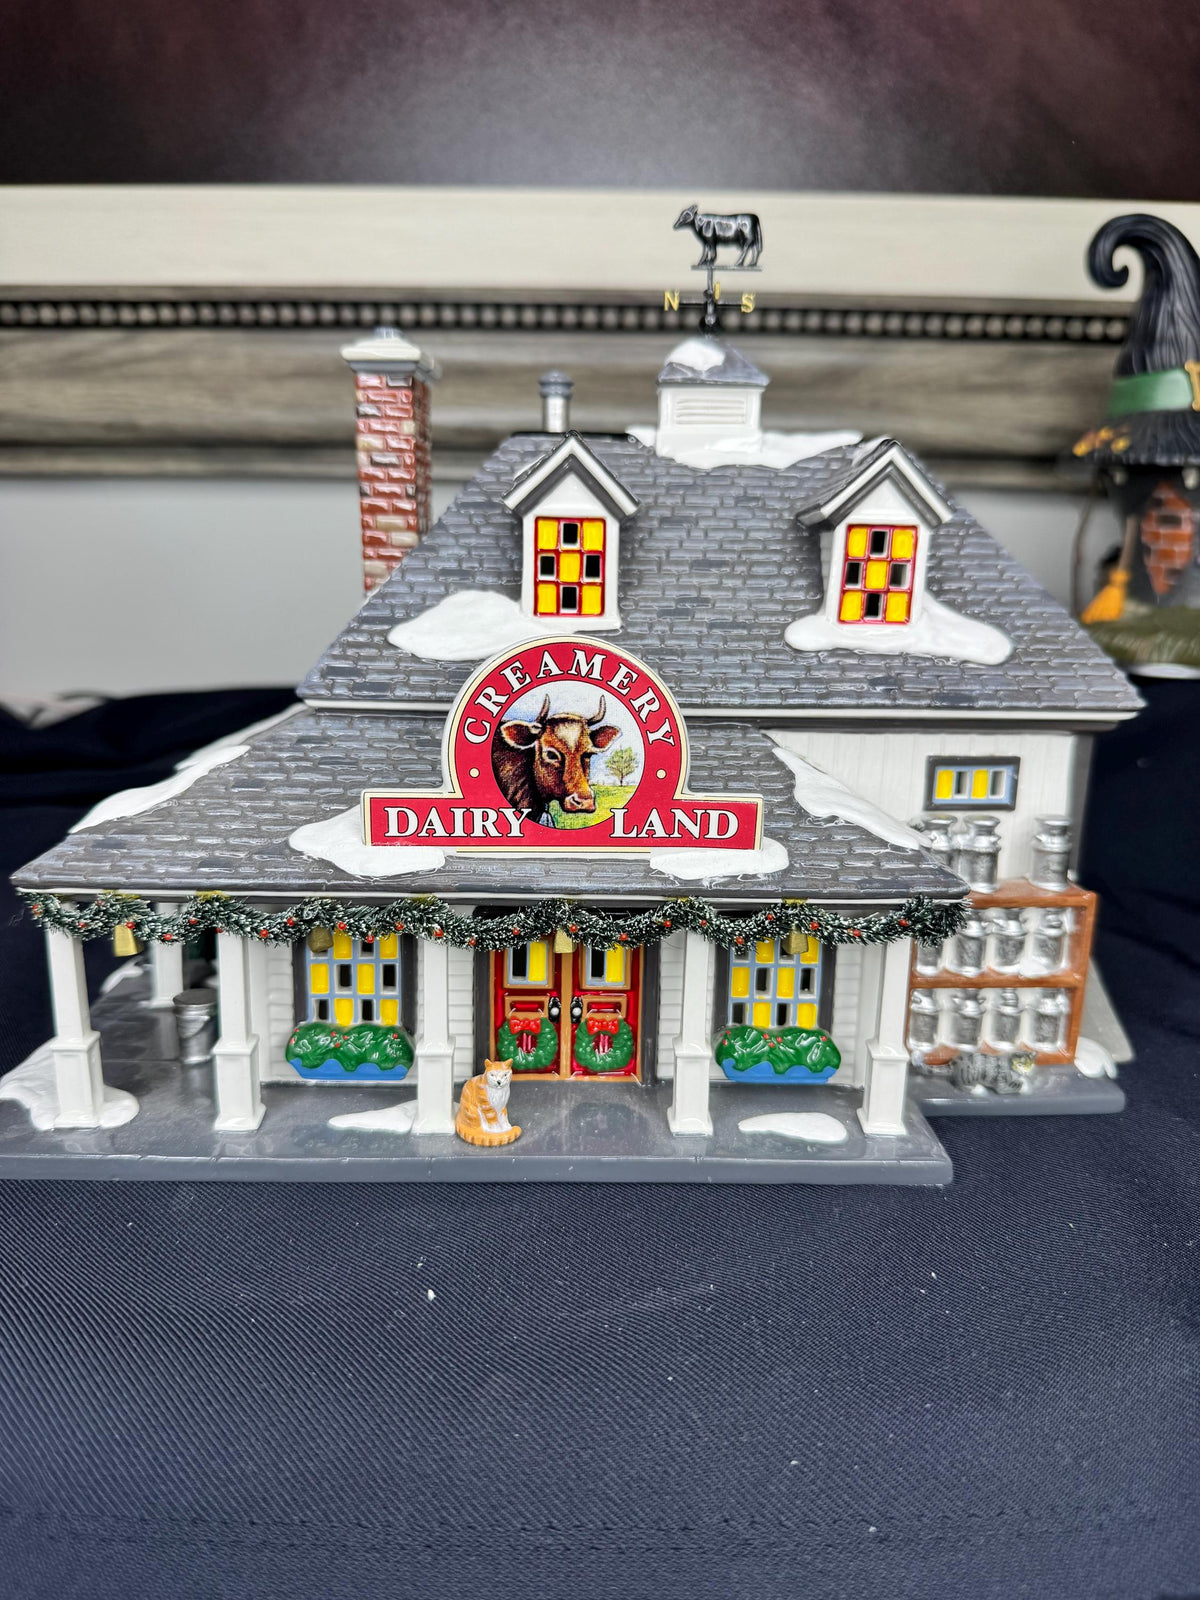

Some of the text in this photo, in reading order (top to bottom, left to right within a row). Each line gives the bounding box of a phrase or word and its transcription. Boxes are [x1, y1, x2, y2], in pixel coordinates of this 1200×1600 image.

[664, 290, 680, 311] N
[741, 292, 755, 313] S
[464, 649, 676, 746] CREAMERY
[384, 807, 740, 840] DAIRY LAND
